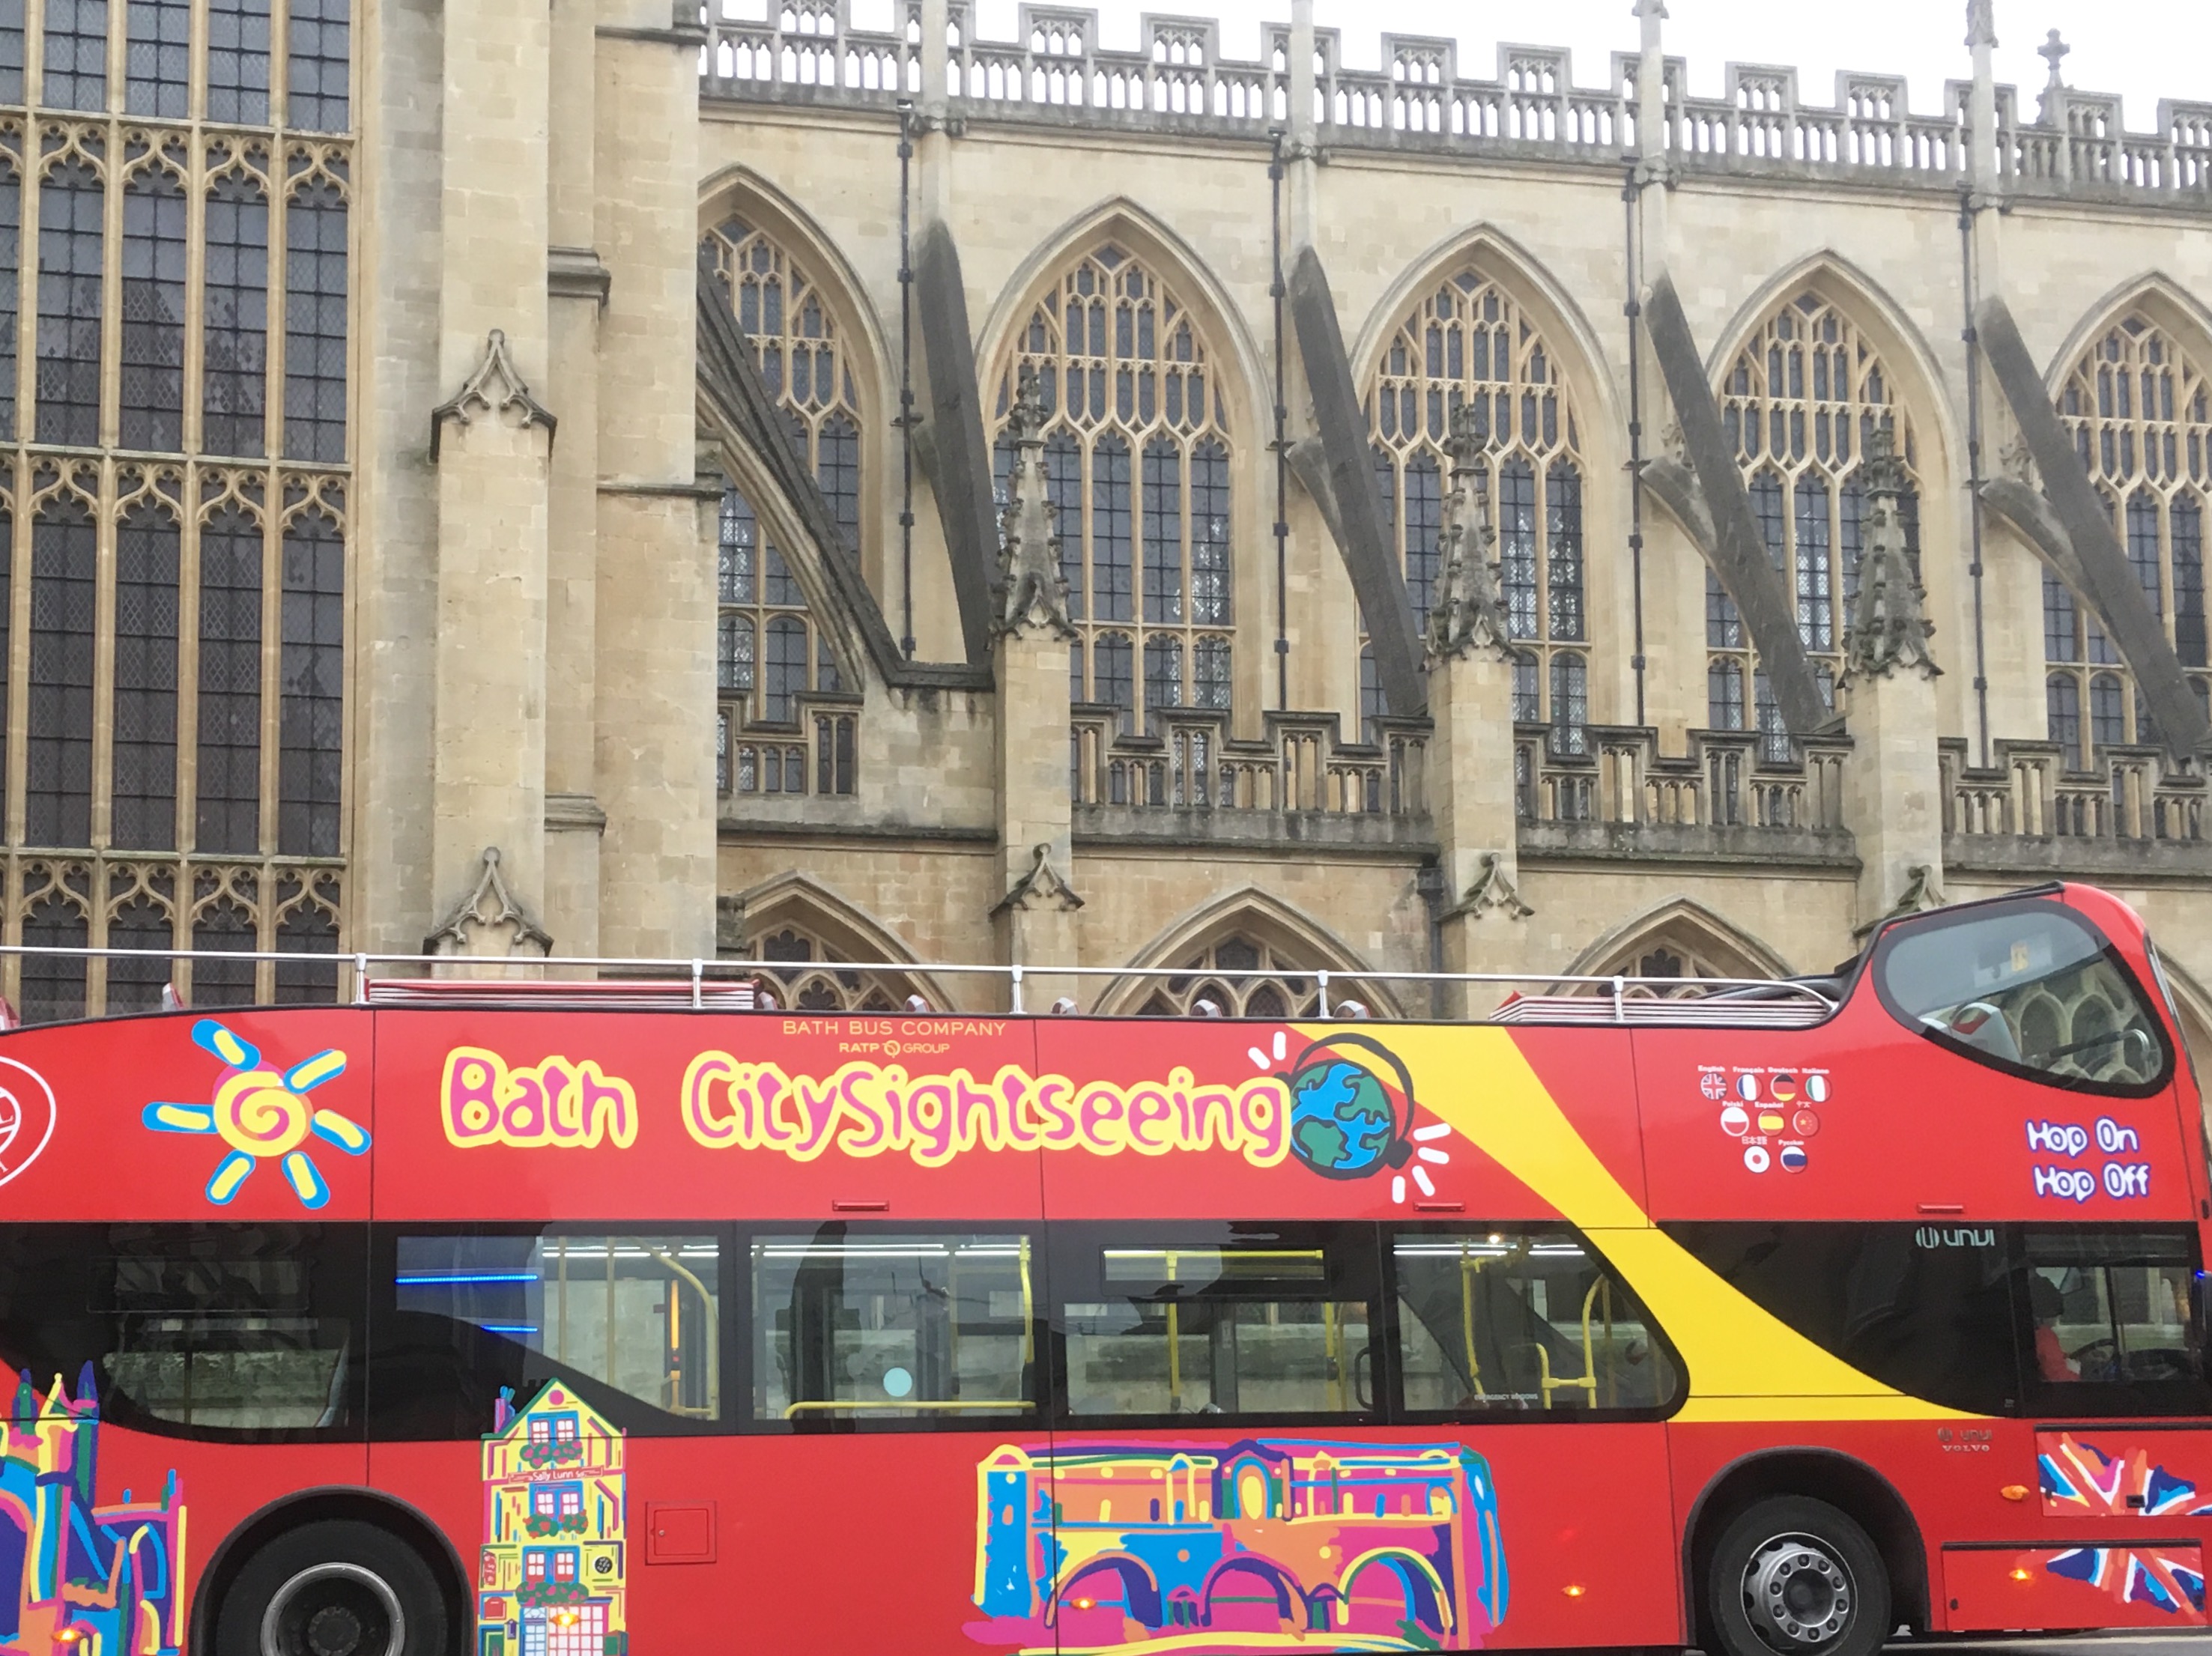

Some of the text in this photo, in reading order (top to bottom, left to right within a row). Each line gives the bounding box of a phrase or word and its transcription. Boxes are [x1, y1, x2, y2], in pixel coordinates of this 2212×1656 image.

[783, 1020, 1006, 1036] BATH BUS COMPANY
[839, 1043, 950, 1054] RATP GROUP
[441, 1046, 1291, 1168] Bath CitySightseeing
[2025, 1114, 2139, 1159] Hop On
[2033, 1160, 2151, 1204] Hop Off
